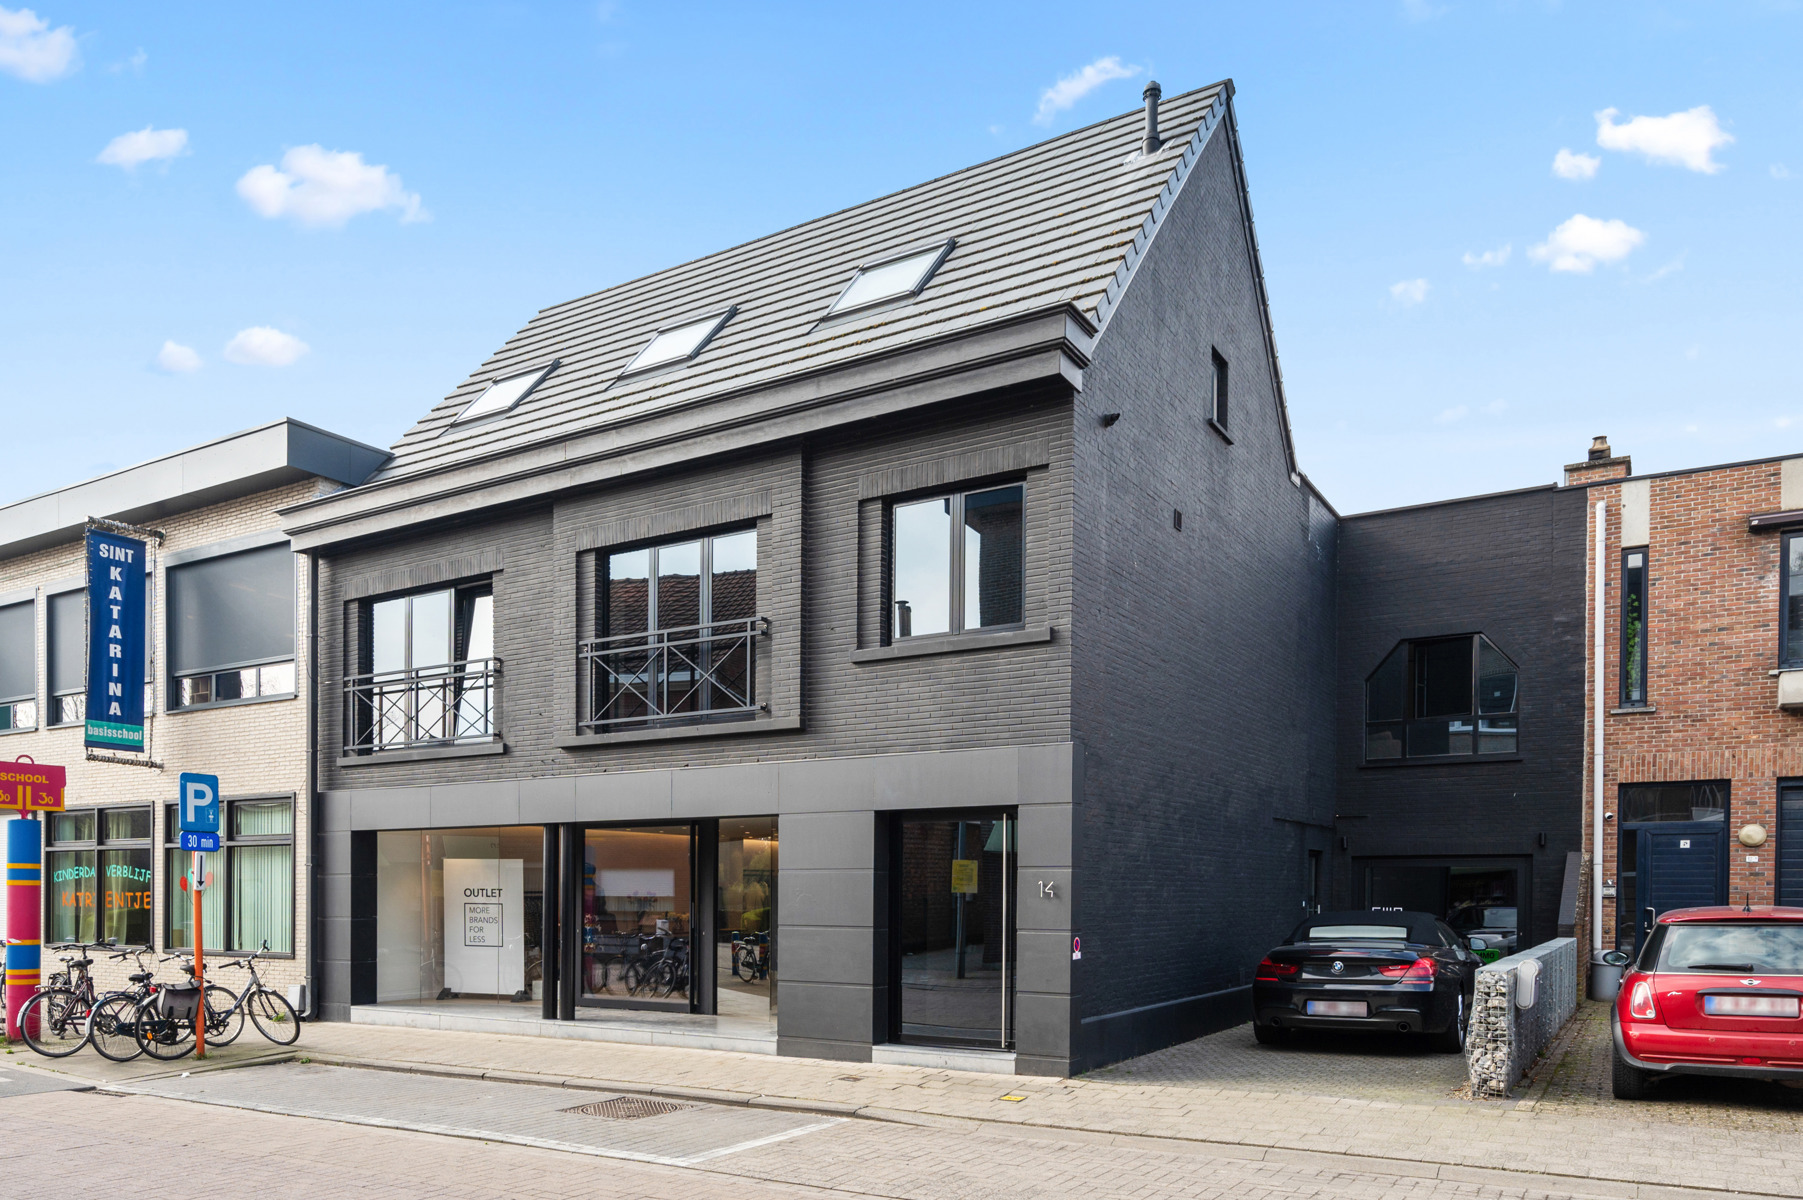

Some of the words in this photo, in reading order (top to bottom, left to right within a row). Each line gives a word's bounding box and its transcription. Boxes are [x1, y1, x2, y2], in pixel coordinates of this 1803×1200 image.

[99, 544, 134, 563] SINT
[108, 566, 122, 716] KATARINA
[87, 724, 143, 741] basisschool
[38, 792, 54, 805] 30
[186, 782, 214, 823] P
[187, 835, 198, 848] 30
[200, 836, 214, 848] min
[464, 888, 503, 897] OUTLET
[1037, 880, 1054, 898] 14
[469, 916, 498, 924] BRANDS
